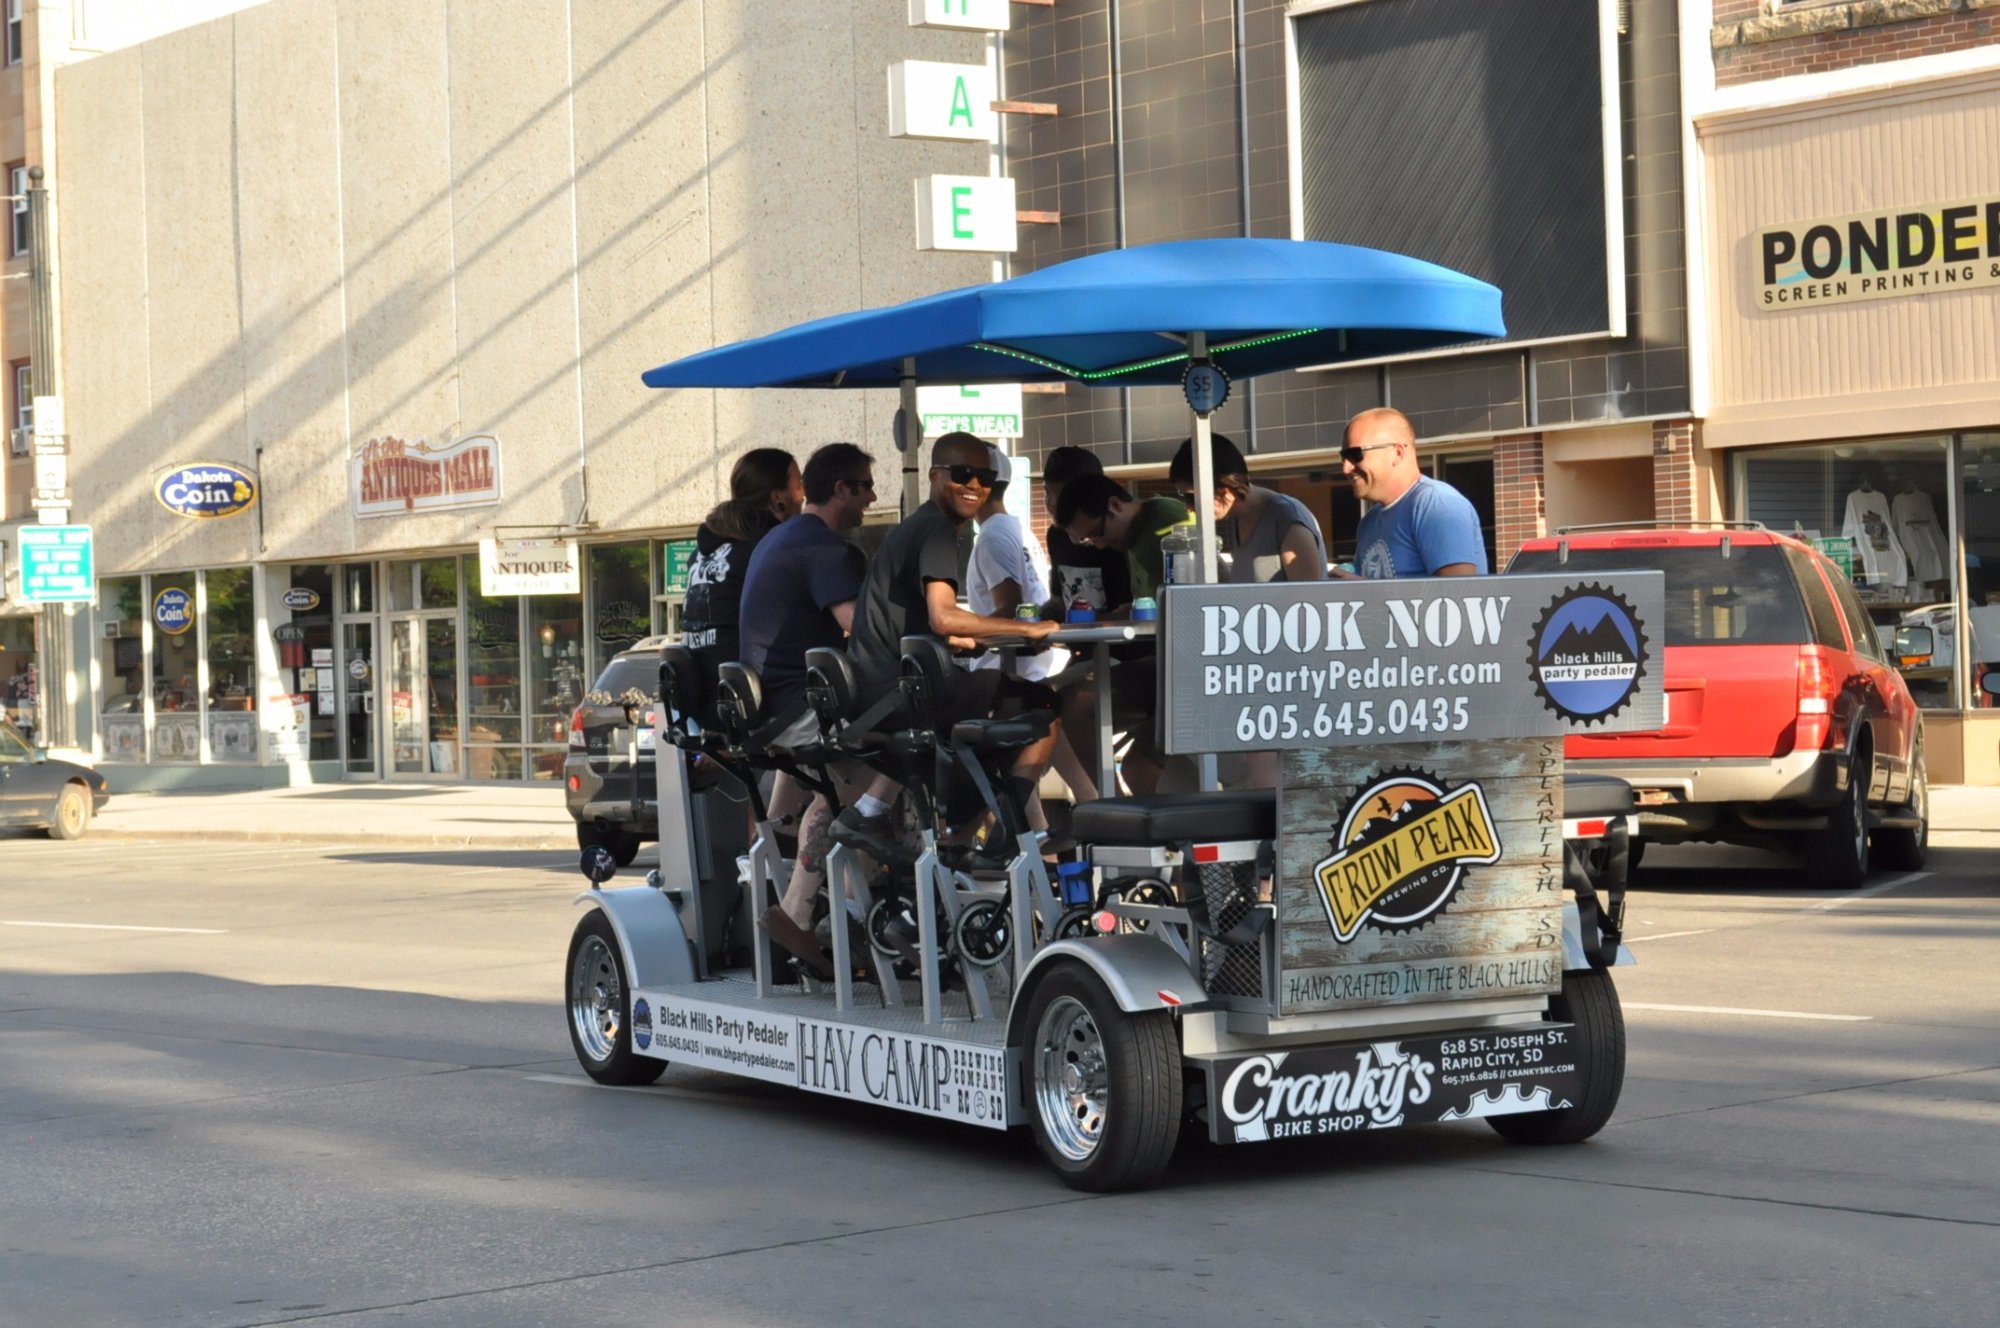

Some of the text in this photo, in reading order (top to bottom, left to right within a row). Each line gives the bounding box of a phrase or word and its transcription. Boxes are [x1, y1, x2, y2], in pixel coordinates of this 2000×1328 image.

[1763, 281, 1848, 304] SCREEN
[1861, 266, 1974, 292] PRINTING
[925, 415, 1016, 433] MEN'S WEAR
[182, 470, 233, 484] Dakota
[360, 446, 495, 512] ANTIQUES MALL
[164, 483, 231, 505] Coin
[284, 595, 311, 605] Coin
[156, 605, 184, 622] Coin
[1200, 595, 1512, 657] BOOK NOW
[276, 627, 304, 640] OPEN
[1553, 651, 1624, 665] black hills
[1203, 656, 1501, 699] BHPartyPedaler.com
[1544, 664, 1635, 681] party pedaler
[1235, 696, 1471, 742] 605.645.0435
[1326, 796, 1489, 928] CROW PEAK
[1379, 863, 1451, 907] BREWING CO.
[1289, 970, 1400, 1004] HANDCRAFTED
[1404, 967, 1423, 994] IN
[1427, 964, 1454, 992] THE
[1458, 961, 1505, 992] BLACK
[660, 1005, 789, 1047] Black Hills Party Pedaler
[655, 1033, 700, 1054] 605.645.0435
[703, 1044, 796, 1073] www.bhpartypedaler.com
[1440, 1039, 1467, 1055] 628
[1523, 1048, 1543, 1063] SD
[799, 1022, 855, 1094] HAY
[861, 1033, 952, 1112] CAMP
[954, 1048, 1004, 1073] BREWING
[954, 1068, 1004, 1093] COMPANY
[1221, 1050, 1436, 1124] Cranky's
[1442, 1069, 1499, 1085] 605.716.0826
[957, 1088, 1004, 1121] RC SD
[1272, 1114, 1366, 1138] BIKE SHOP
